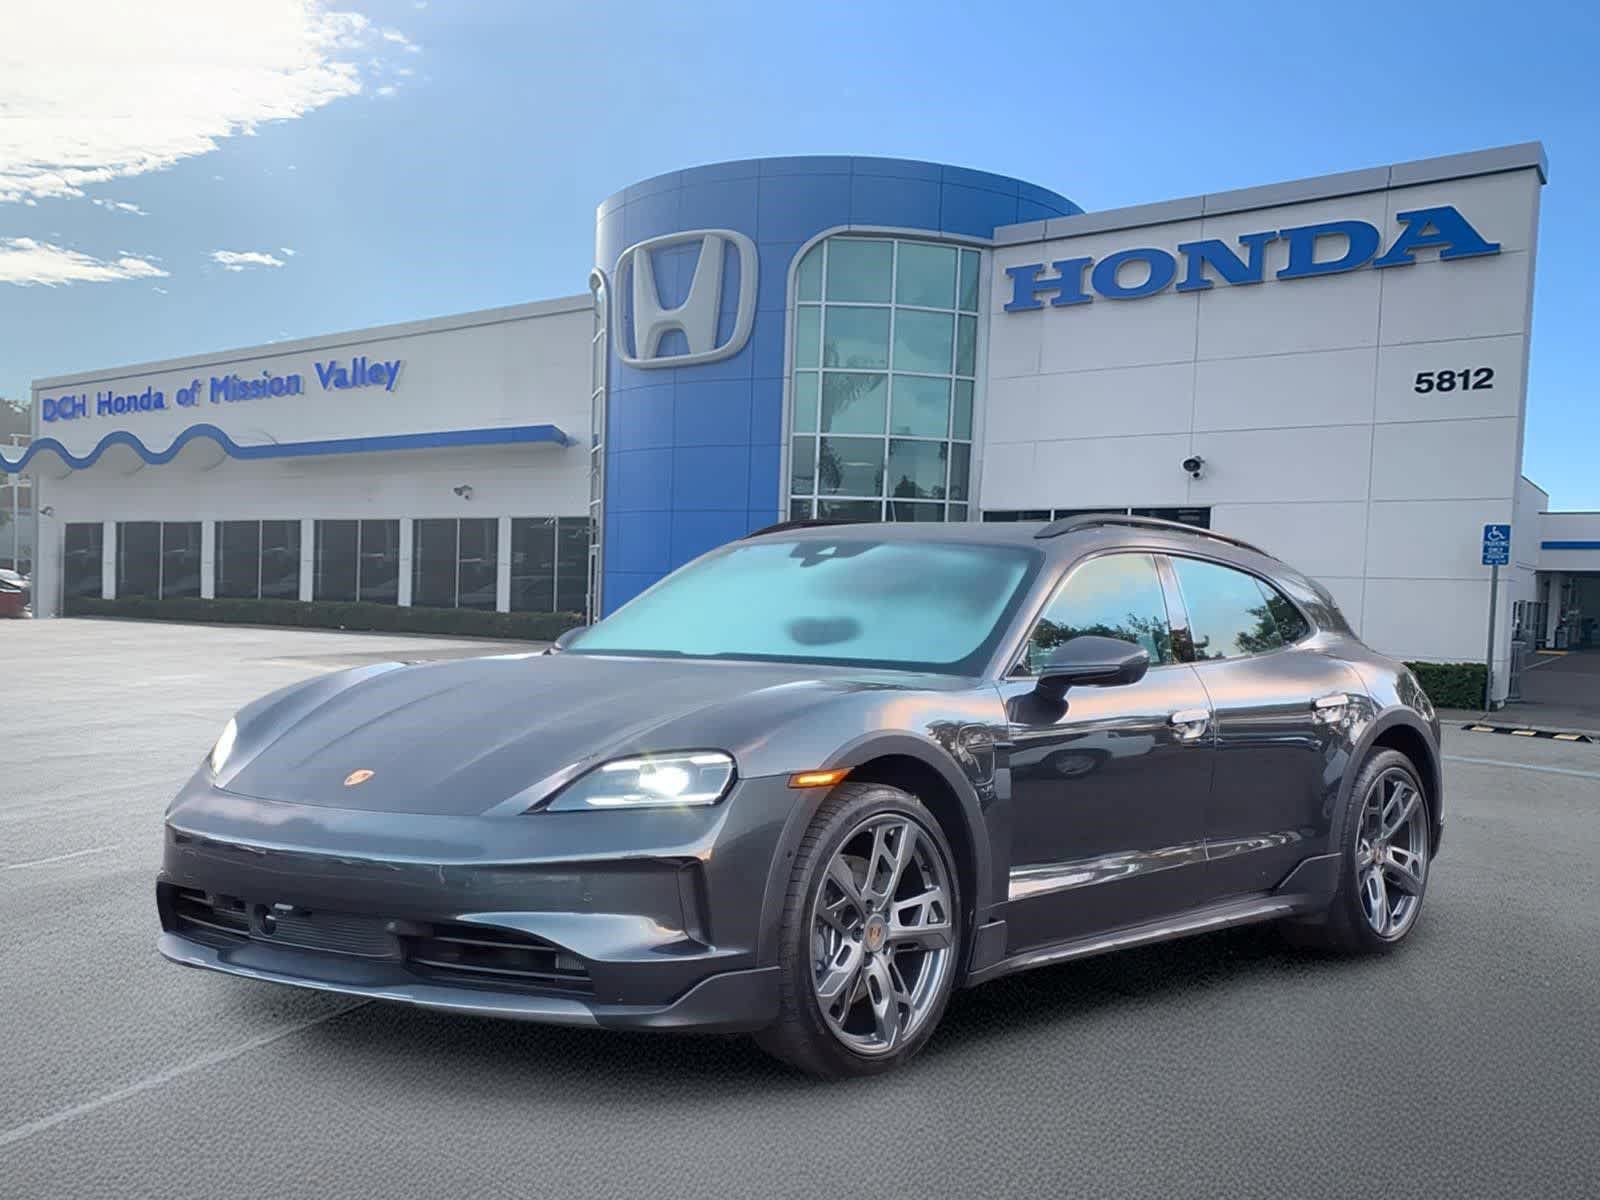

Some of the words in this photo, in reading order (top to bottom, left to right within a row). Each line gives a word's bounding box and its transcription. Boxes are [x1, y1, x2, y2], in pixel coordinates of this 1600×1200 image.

[1004, 205, 1501, 313] HONDA
[42, 394, 87, 422] DCH
[96, 385, 165, 416] Honda
[176, 379, 201, 407] of
[209, 370, 303, 403] Mission
[314, 356, 402, 391] Valley
[1413, 367, 1494, 394] 5812
